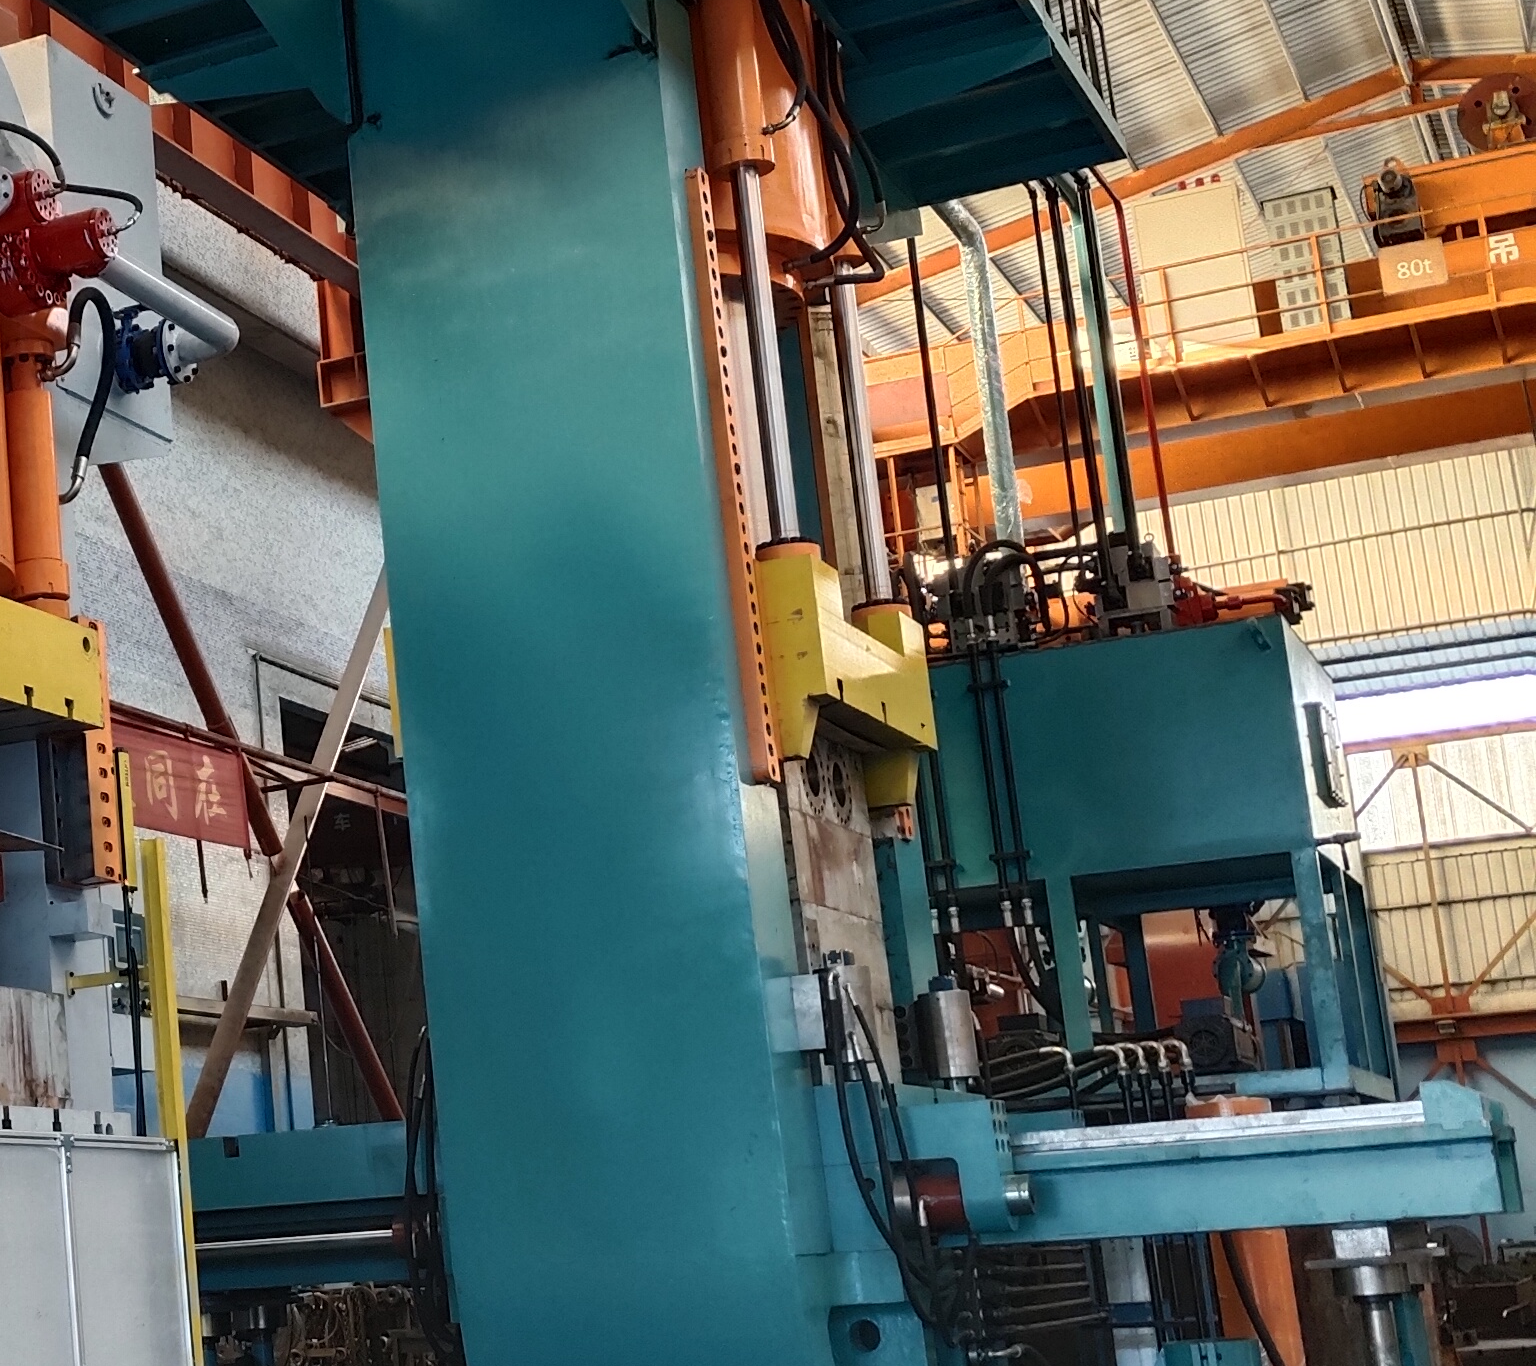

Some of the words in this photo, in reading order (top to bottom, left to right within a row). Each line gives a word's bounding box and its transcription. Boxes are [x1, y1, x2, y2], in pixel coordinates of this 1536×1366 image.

[1488, 232, 1520, 265] 吊
[1396, 258, 1434, 280] 80t
[133, 749, 227, 826] 同在
